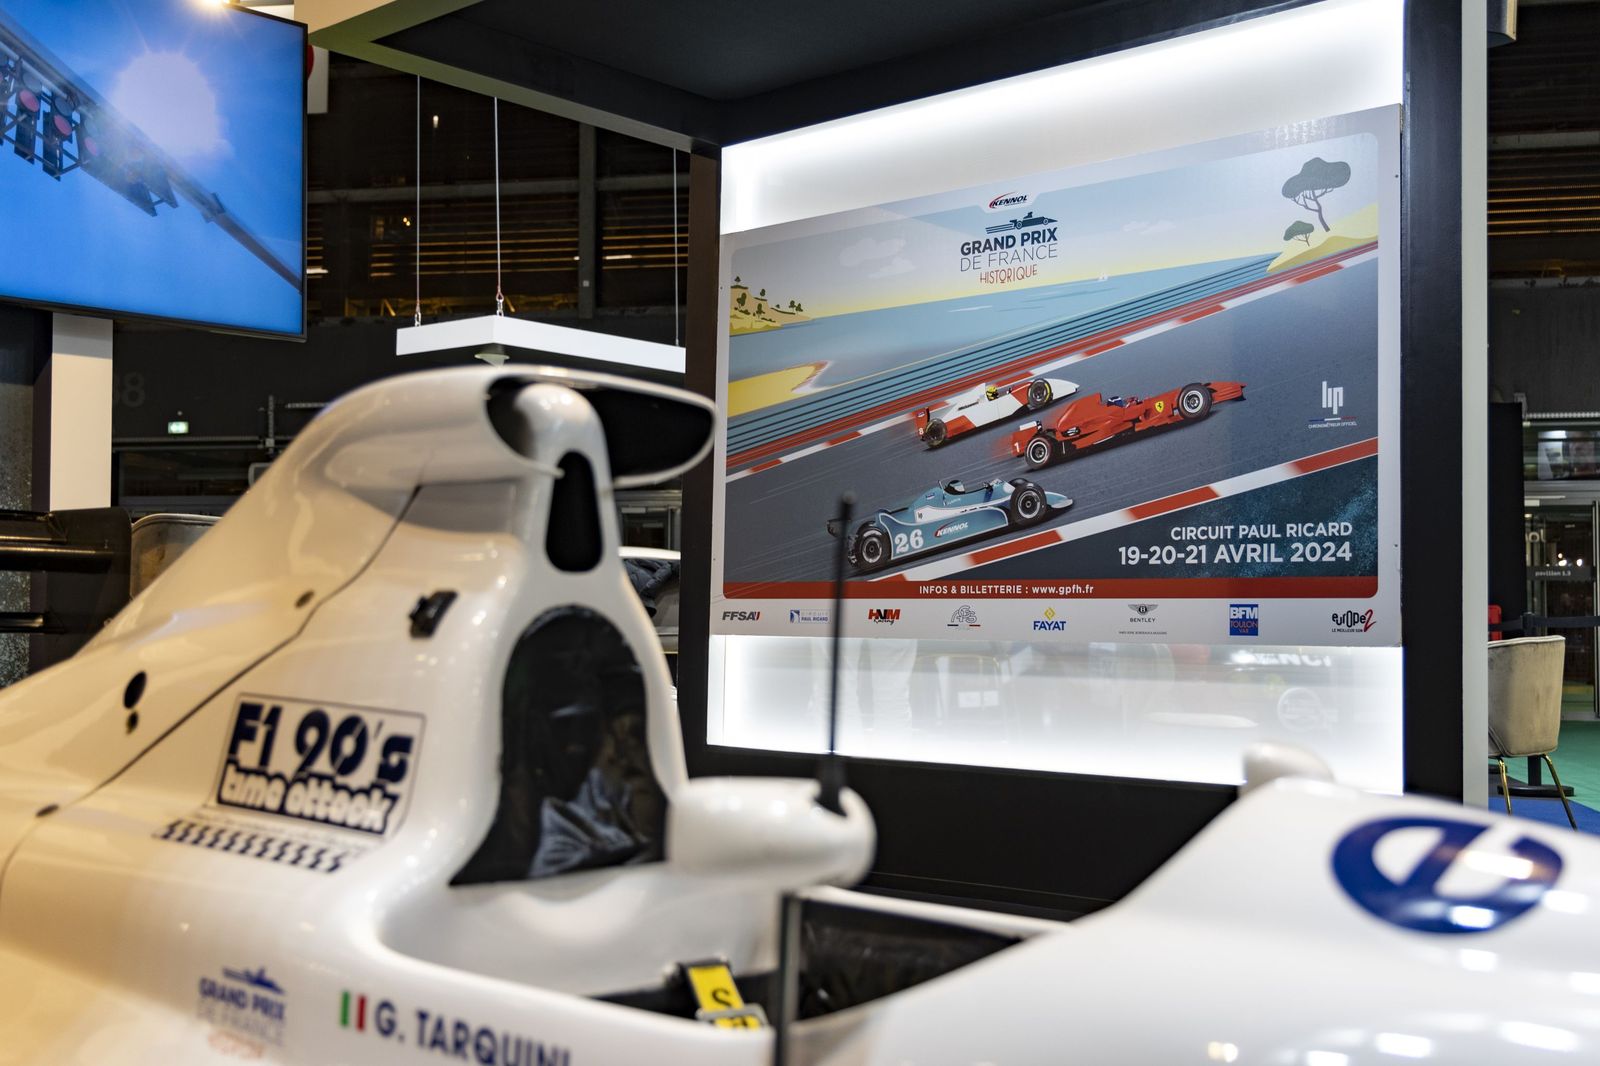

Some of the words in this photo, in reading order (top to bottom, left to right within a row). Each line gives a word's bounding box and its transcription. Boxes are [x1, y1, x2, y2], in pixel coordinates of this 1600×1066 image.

[991, 194, 1028, 207] KENNOL
[960, 234, 1016, 256] GRAND
[1020, 226, 1058, 247] PRIX
[960, 255, 982, 272] DE
[987, 242, 1058, 268] FRANCE
[979, 263, 1038, 285] HISTORIQUE
[1014, 441, 1020, 453] 1
[936, 521, 969, 538] KENNOL
[1170, 525, 1234, 541] CIRCUIT
[1238, 523, 1282, 539] PAUL
[1286, 521, 1353, 537] RICARD
[894, 528, 924, 554] 26
[1118, 544, 1207, 566] 19-20-21
[1213, 542, 1283, 564] AVRIL
[1290, 541, 1352, 563] 2024
[919, 584, 948, 595] INFOS
[950, 585, 957, 595] &
[960, 584, 1022, 595] BILLETTERIE
[1031, 584, 1095, 597] www.gpfh.fr
[722, 611, 760, 621] FFSA
[1230, 606, 1258, 619] BFM
[1363, 608, 1377, 632] 2
[1033, 620, 1067, 631] FAYAT
[1230, 620, 1258, 628] TOULON
[228, 702, 283, 769] F1
[251, 992, 286, 1022] PRIX
[374, 1000, 405, 1043] G.
